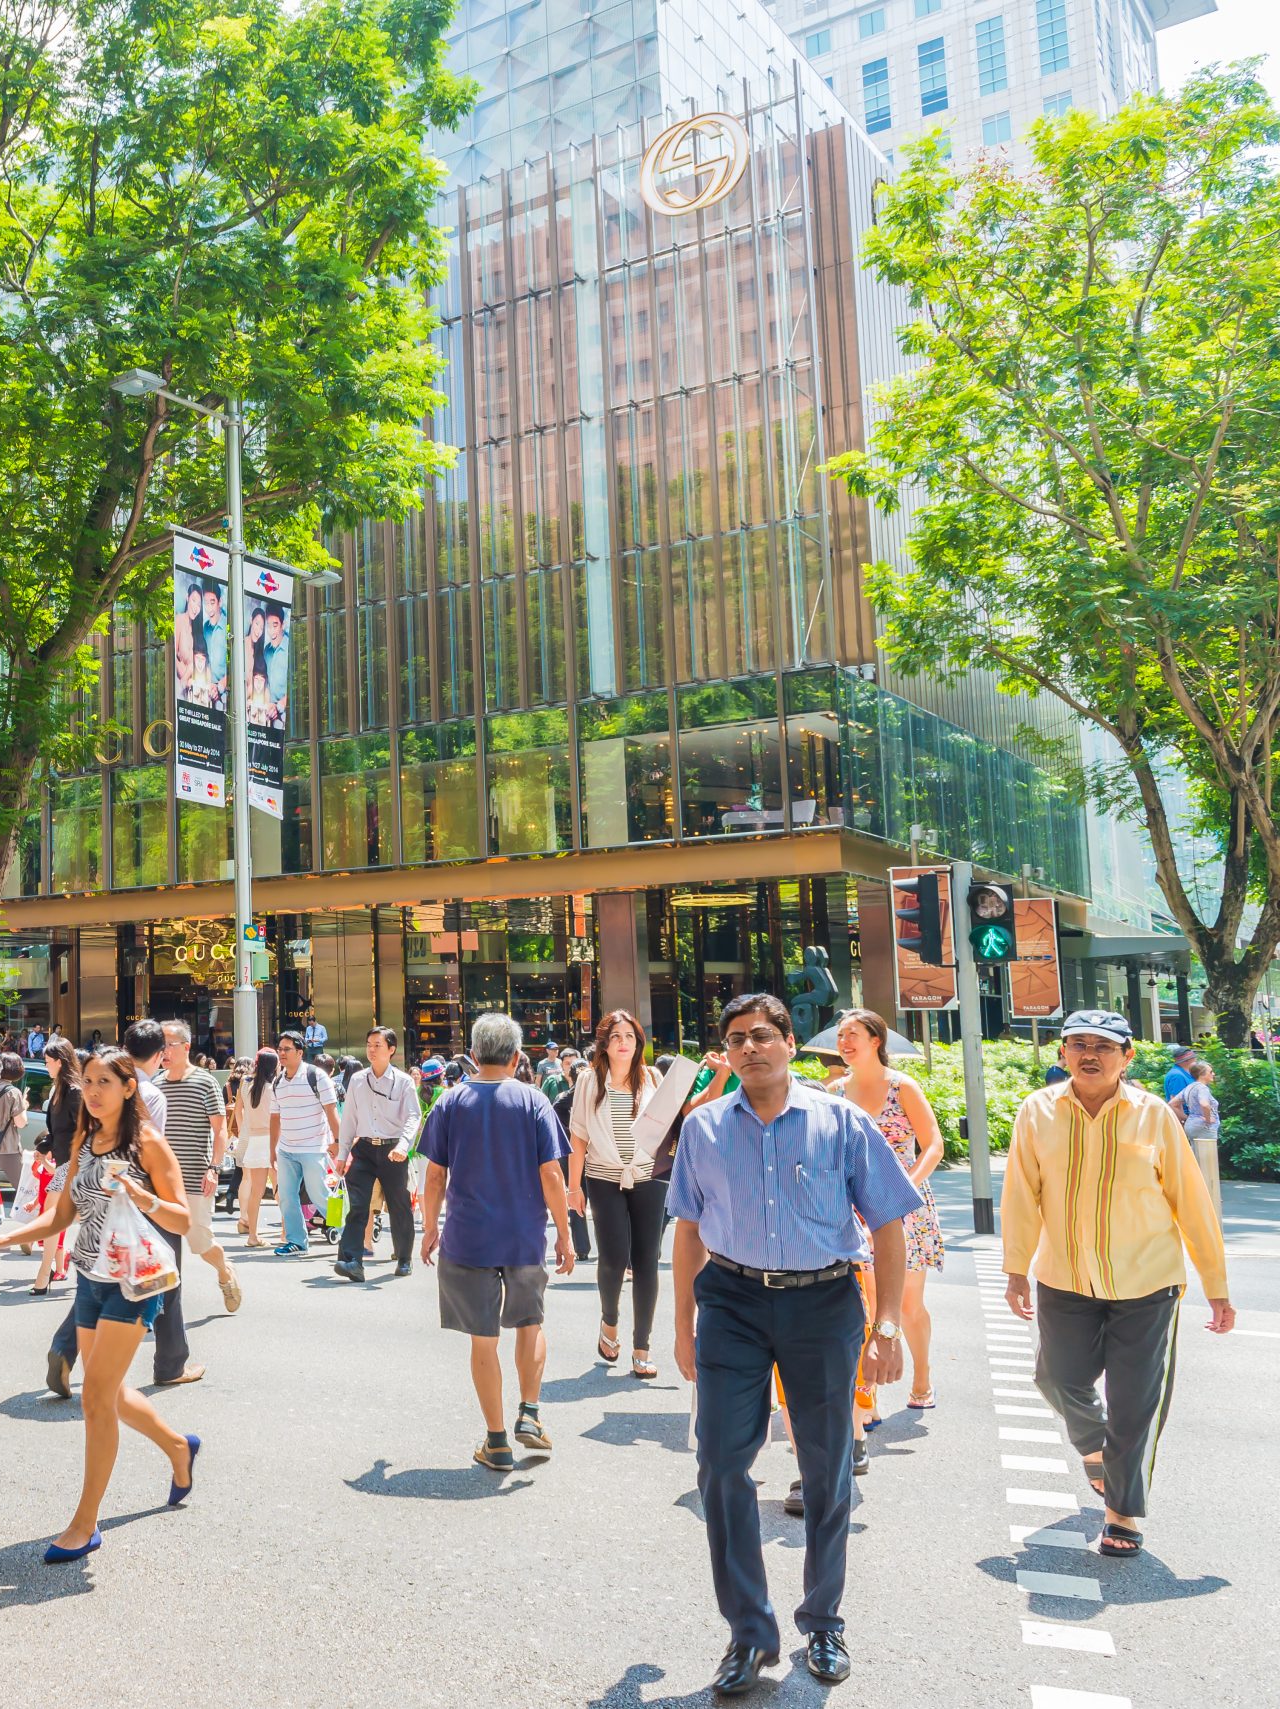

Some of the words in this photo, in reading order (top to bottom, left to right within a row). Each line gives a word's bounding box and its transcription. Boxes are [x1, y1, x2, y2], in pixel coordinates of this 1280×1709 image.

[184, 708, 201, 719] THRILLED
[179, 715, 190, 723] GREAT
[191, 718, 211, 728] SINGAPORE
[210, 748, 220, 756] 2014
[269, 765, 278, 773] 2014
[175, 944, 237, 962] GUCC
